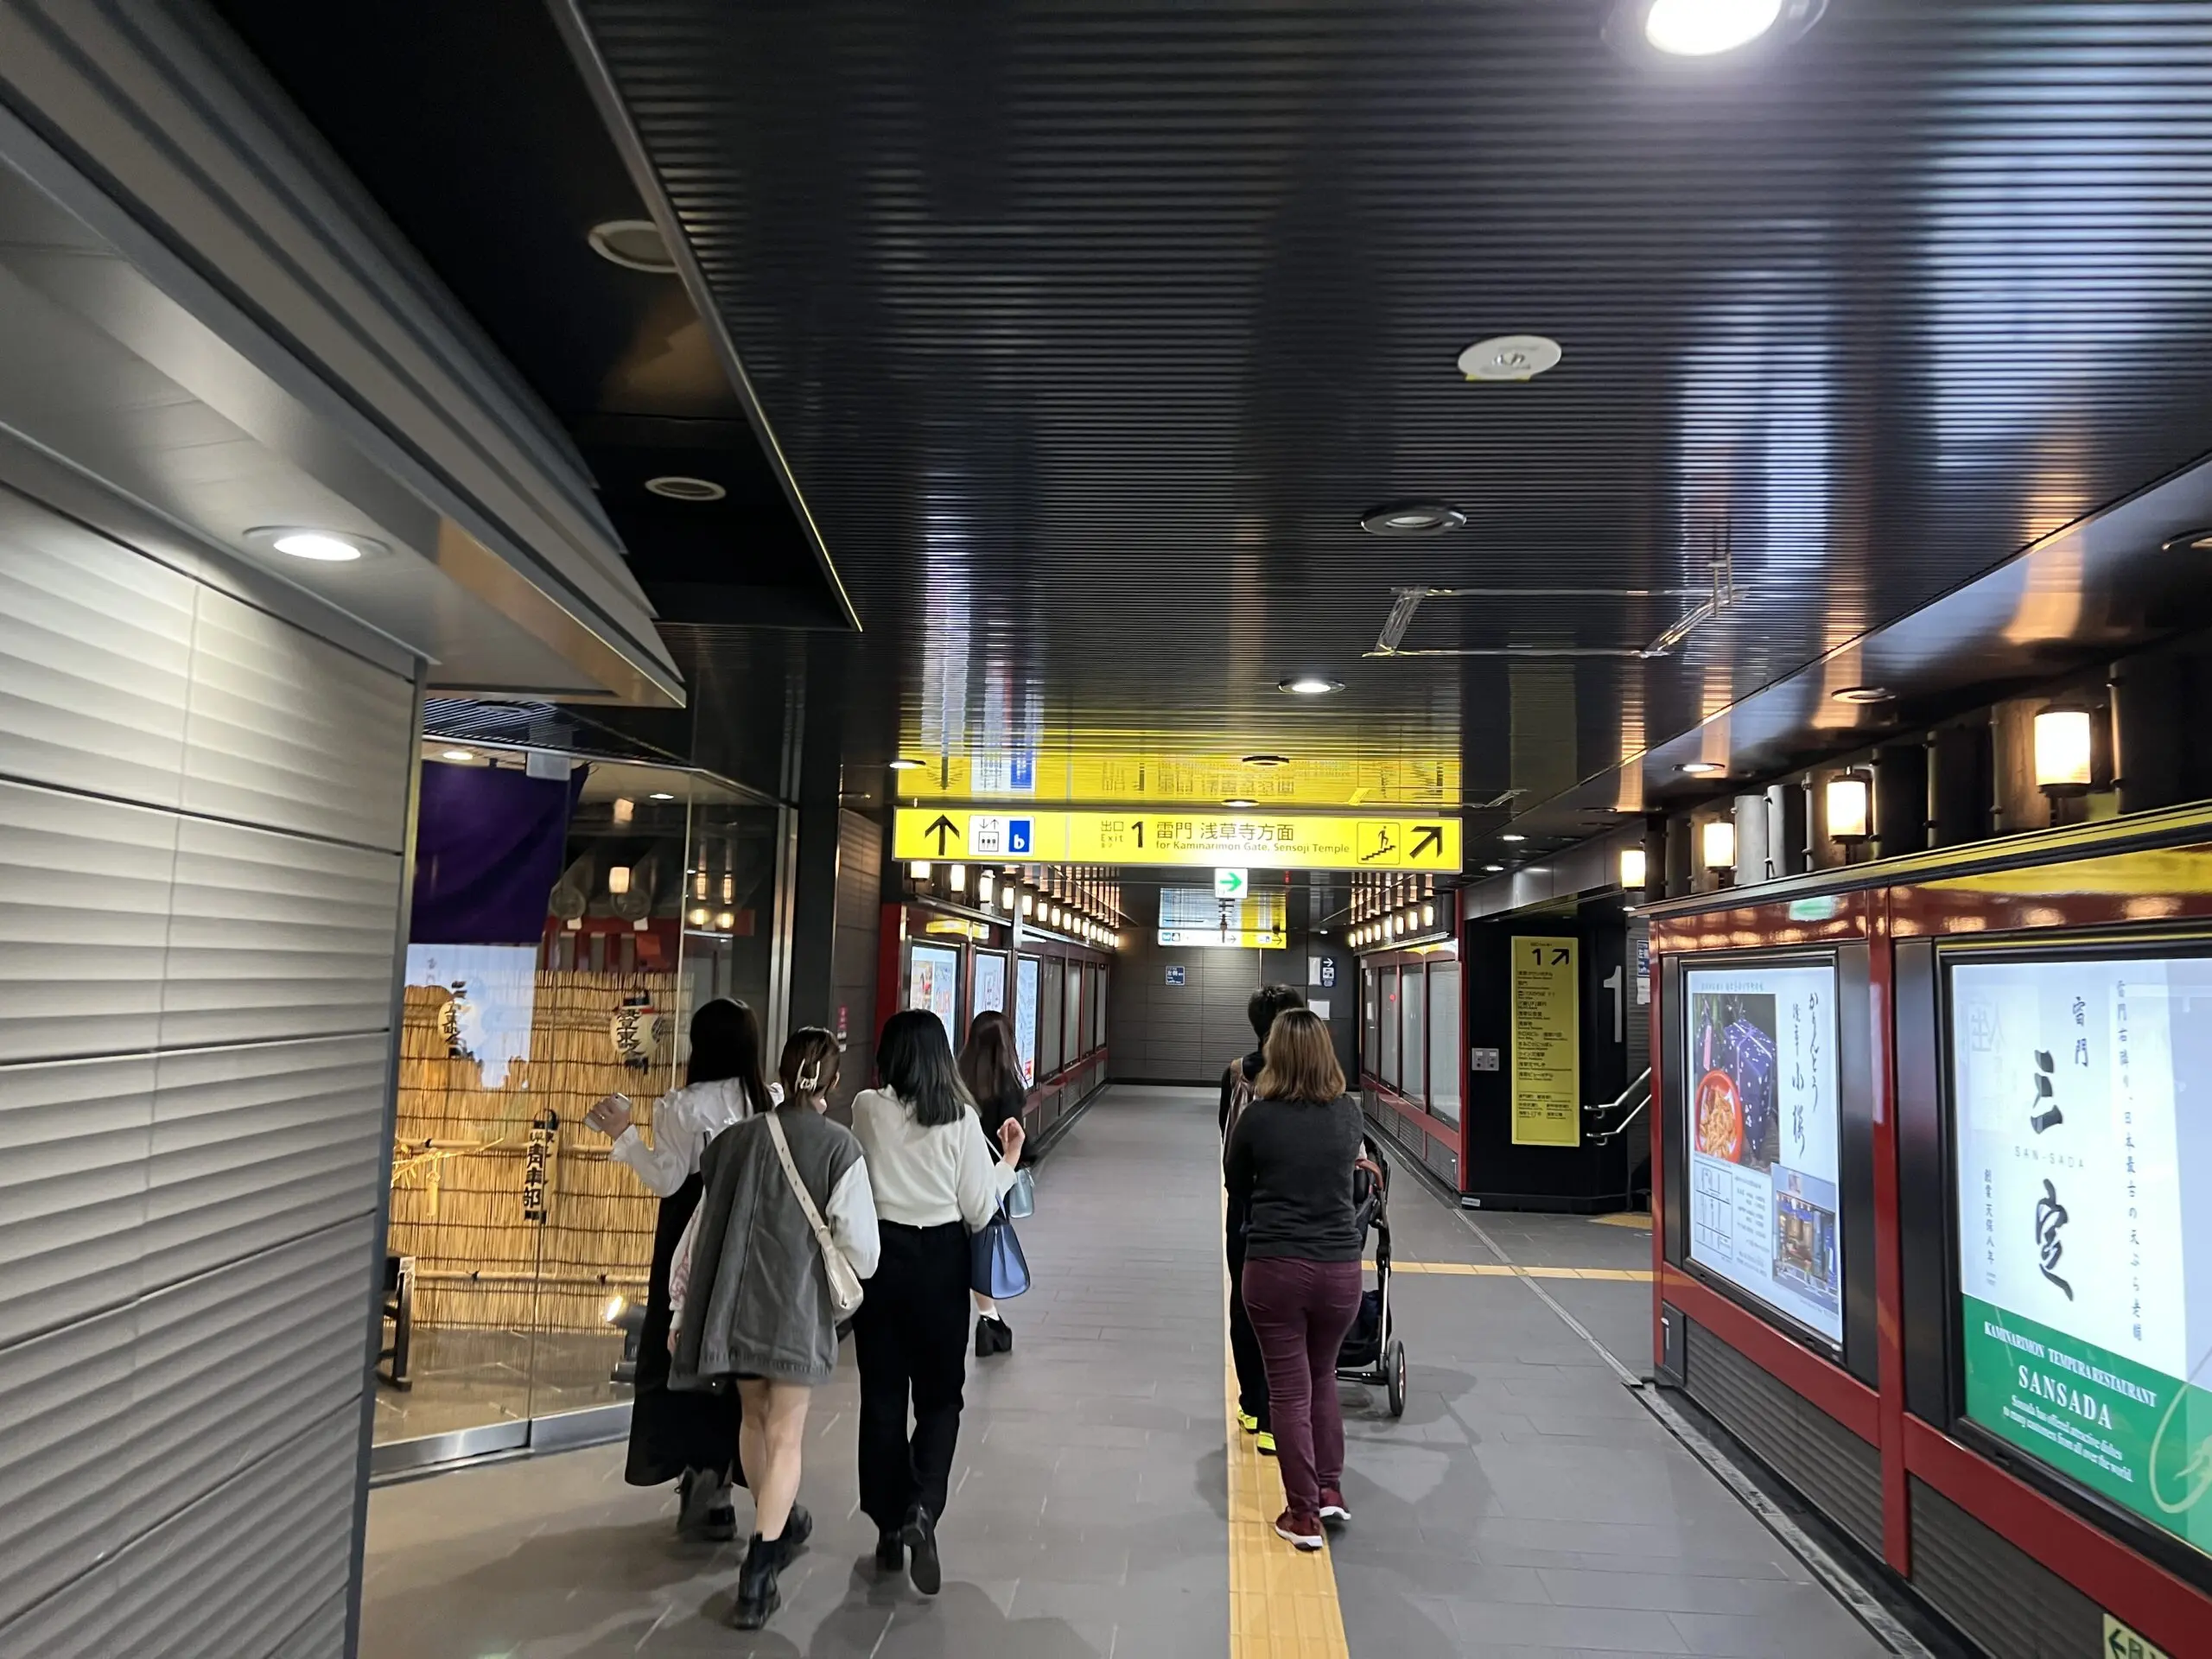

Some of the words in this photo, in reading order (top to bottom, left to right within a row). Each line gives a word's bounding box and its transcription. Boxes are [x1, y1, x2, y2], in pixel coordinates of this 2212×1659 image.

[1101, 820, 1124, 832] 出口
[1131, 821, 1143, 848] 1
[1157, 822, 1192, 840] 雷門
[1200, 823, 1294, 841] 浅草寺方面
[1101, 834, 1123, 842] Exit
[1156, 841, 1170, 849] for
[1173, 841, 1240, 850] Kaminarimon
[1274, 842, 1309, 854] Sensoji
[1313, 844, 1350, 855] Temple
[1532, 948, 1541, 966] 1
[1603, 965, 1622, 1043] 1
[1984, 1321, 2045, 1358] KAMINARIMON
[2018, 1364, 2113, 1430] SANSADA
